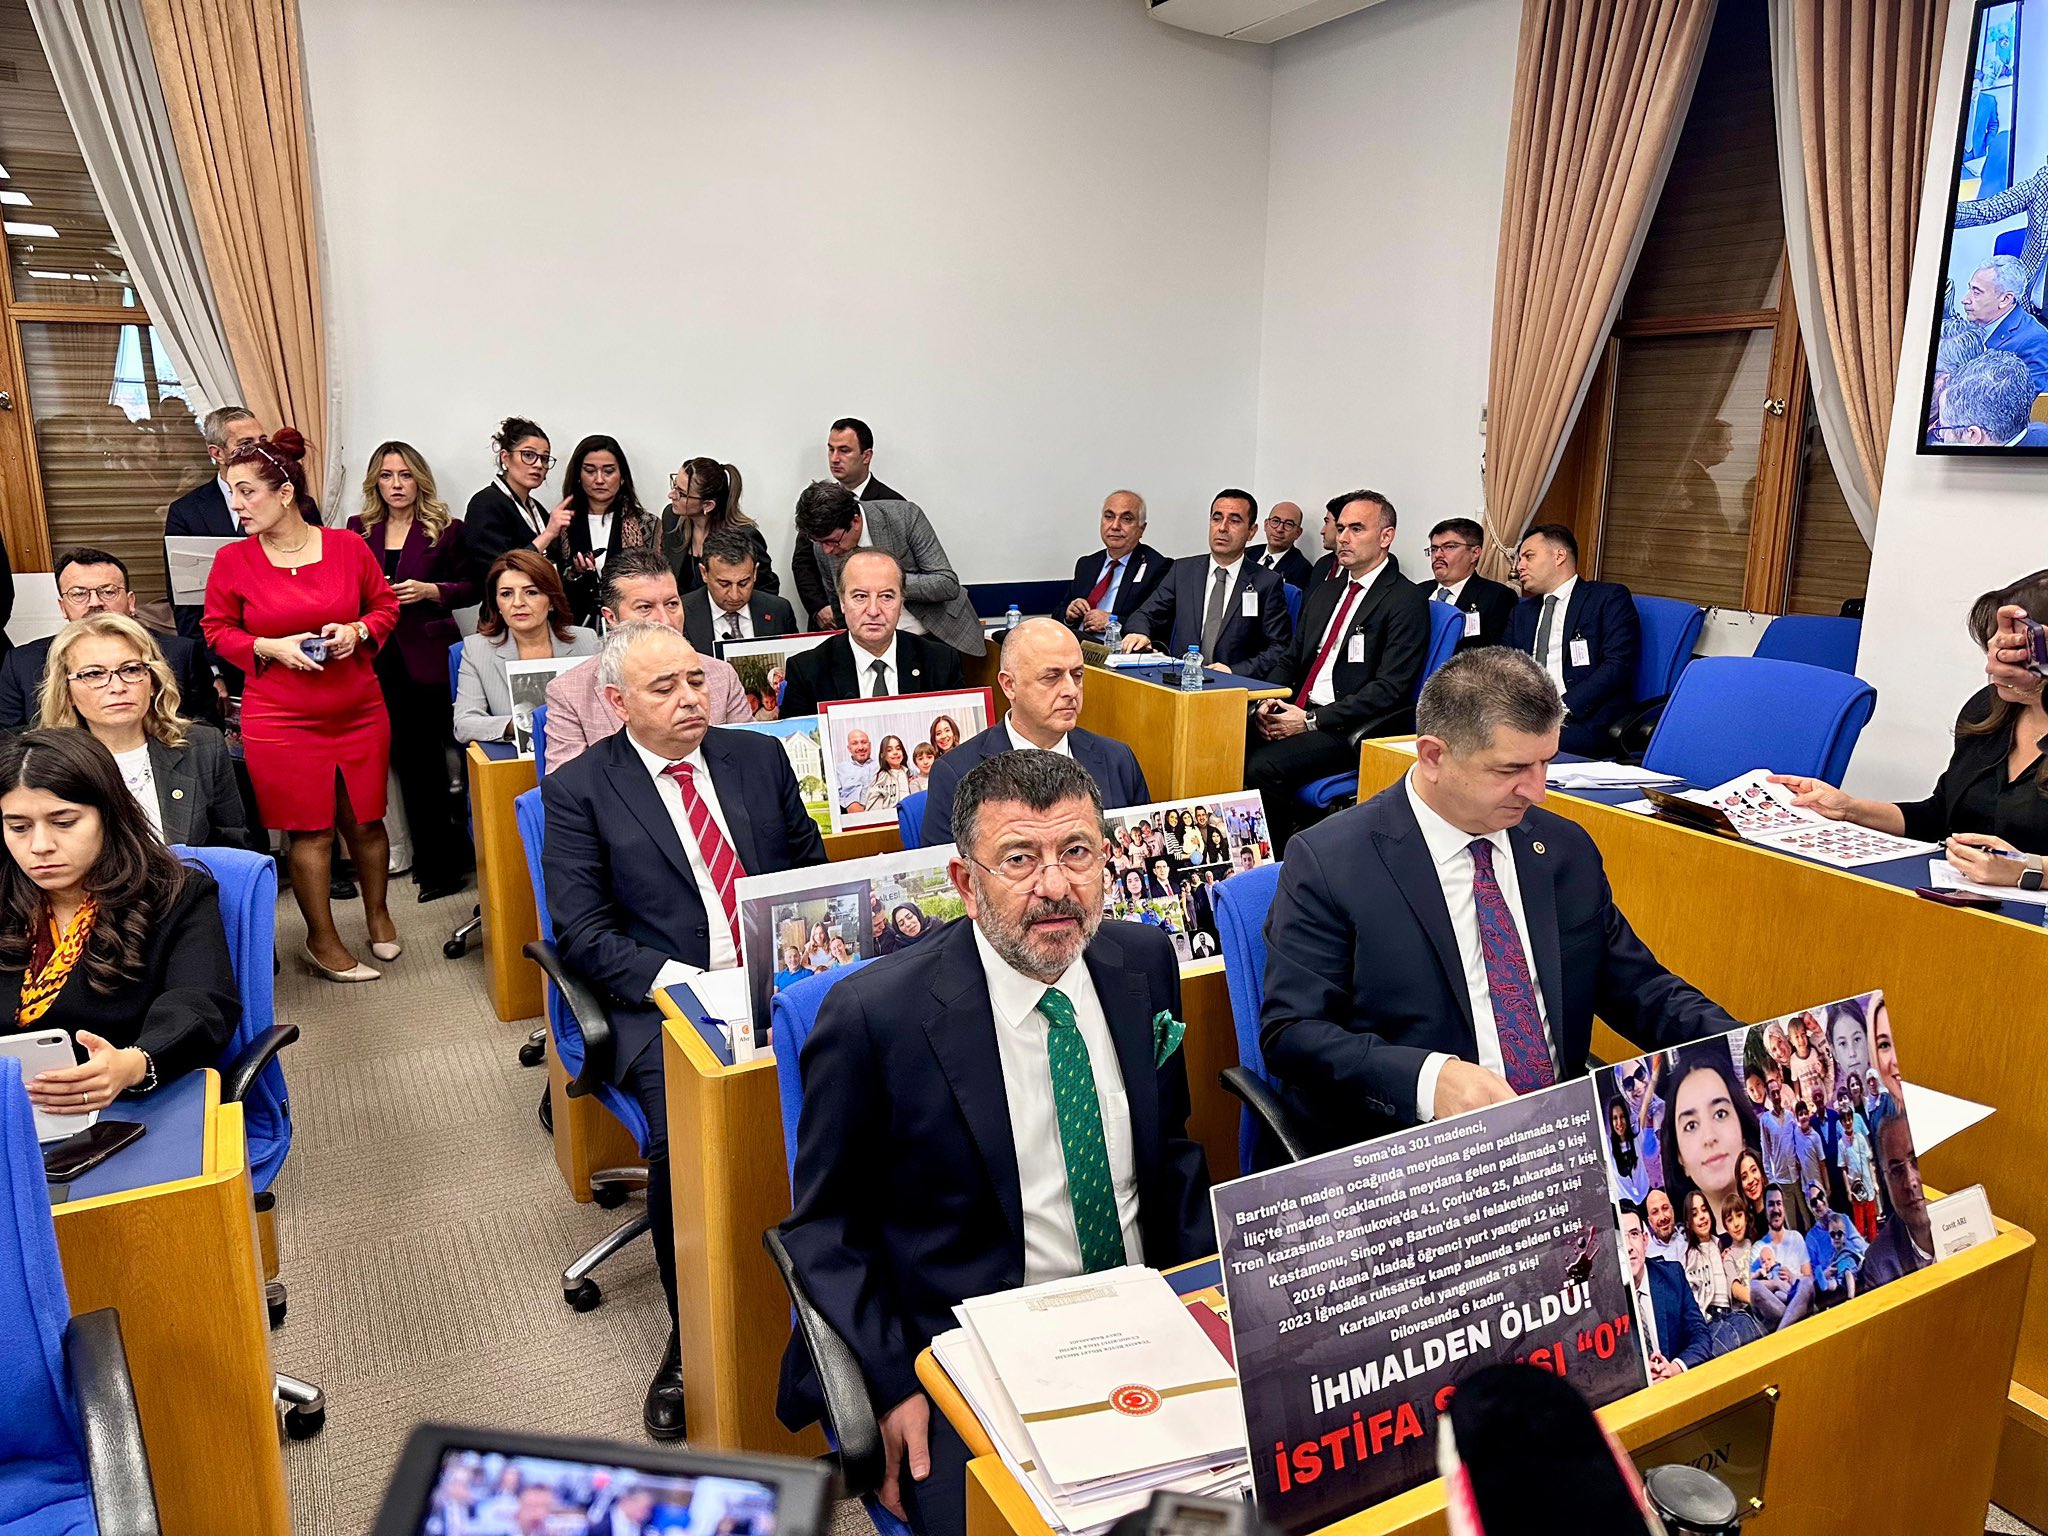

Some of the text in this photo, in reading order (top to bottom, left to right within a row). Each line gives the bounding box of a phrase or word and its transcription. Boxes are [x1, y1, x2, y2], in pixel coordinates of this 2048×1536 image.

[1285, 1212, 1331, 1235] maden
[1332, 1188, 1408, 1220] ocaklarında
[1409, 1172, 1464, 1197] meydana
[1464, 1162, 1497, 1183] gelen
[1498, 1143, 1557, 1172] patlamada
[1557, 1139, 1566, 1151] 9
[1567, 1131, 1587, 1148] kişi
[1300, 1185, 1345, 1207] maden
[1346, 1167, 1407, 1193] ocağında
[1406, 1151, 1461, 1176] meydana
[1462, 1141, 1495, 1162] gelen
[1496, 1122, 1555, 1151] patlamada
[1555, 1117, 1570, 1130] 42
[1570, 1109, 1591, 1128] işçi
[1408, 1135, 1432, 1152] 301
[1433, 1119, 1487, 1145] madenci,
[1231, 1257, 1265, 1275] Tren
[1266, 1234, 1335, 1265] kazasında
[1420, 1201, 1440, 1215] 41,
[1491, 1178, 1511, 1194] 25,
[1512, 1162, 1565, 1188] Ankarada
[1568, 1156, 1576, 1169] 7
[1577, 1149, 1598, 1166] kişi
[1268, 1255, 1348, 1289] Kastamonu,
[1350, 1242, 1386, 1262] Sinop
[1387, 1236, 1404, 1249] ve
[1462, 1208, 1481, 1225] sel
[1482, 1189, 1545, 1219] felaketinde
[1546, 1182, 1560, 1197] 97
[1562, 1175, 1582, 1192] kişi
[1292, 1200, 1569, 1305] 2016 Adana Aladağ öğrenci yurt yangını 12 kişi
[1278, 1217, 1583, 1334] 2023 İğneada ruhsatsız kamp alanında selden 6 kişi
[1339, 1254, 1540, 1337] Kartalkaya otel yangınında 78 kişi
[1390, 1291, 1505, 1342] Dilovasında 6 kadın
[1310, 1278, 1592, 1415] İHMALDEN ÖLDÜ!
[1275, 1402, 1424, 1493] İSTİFA
